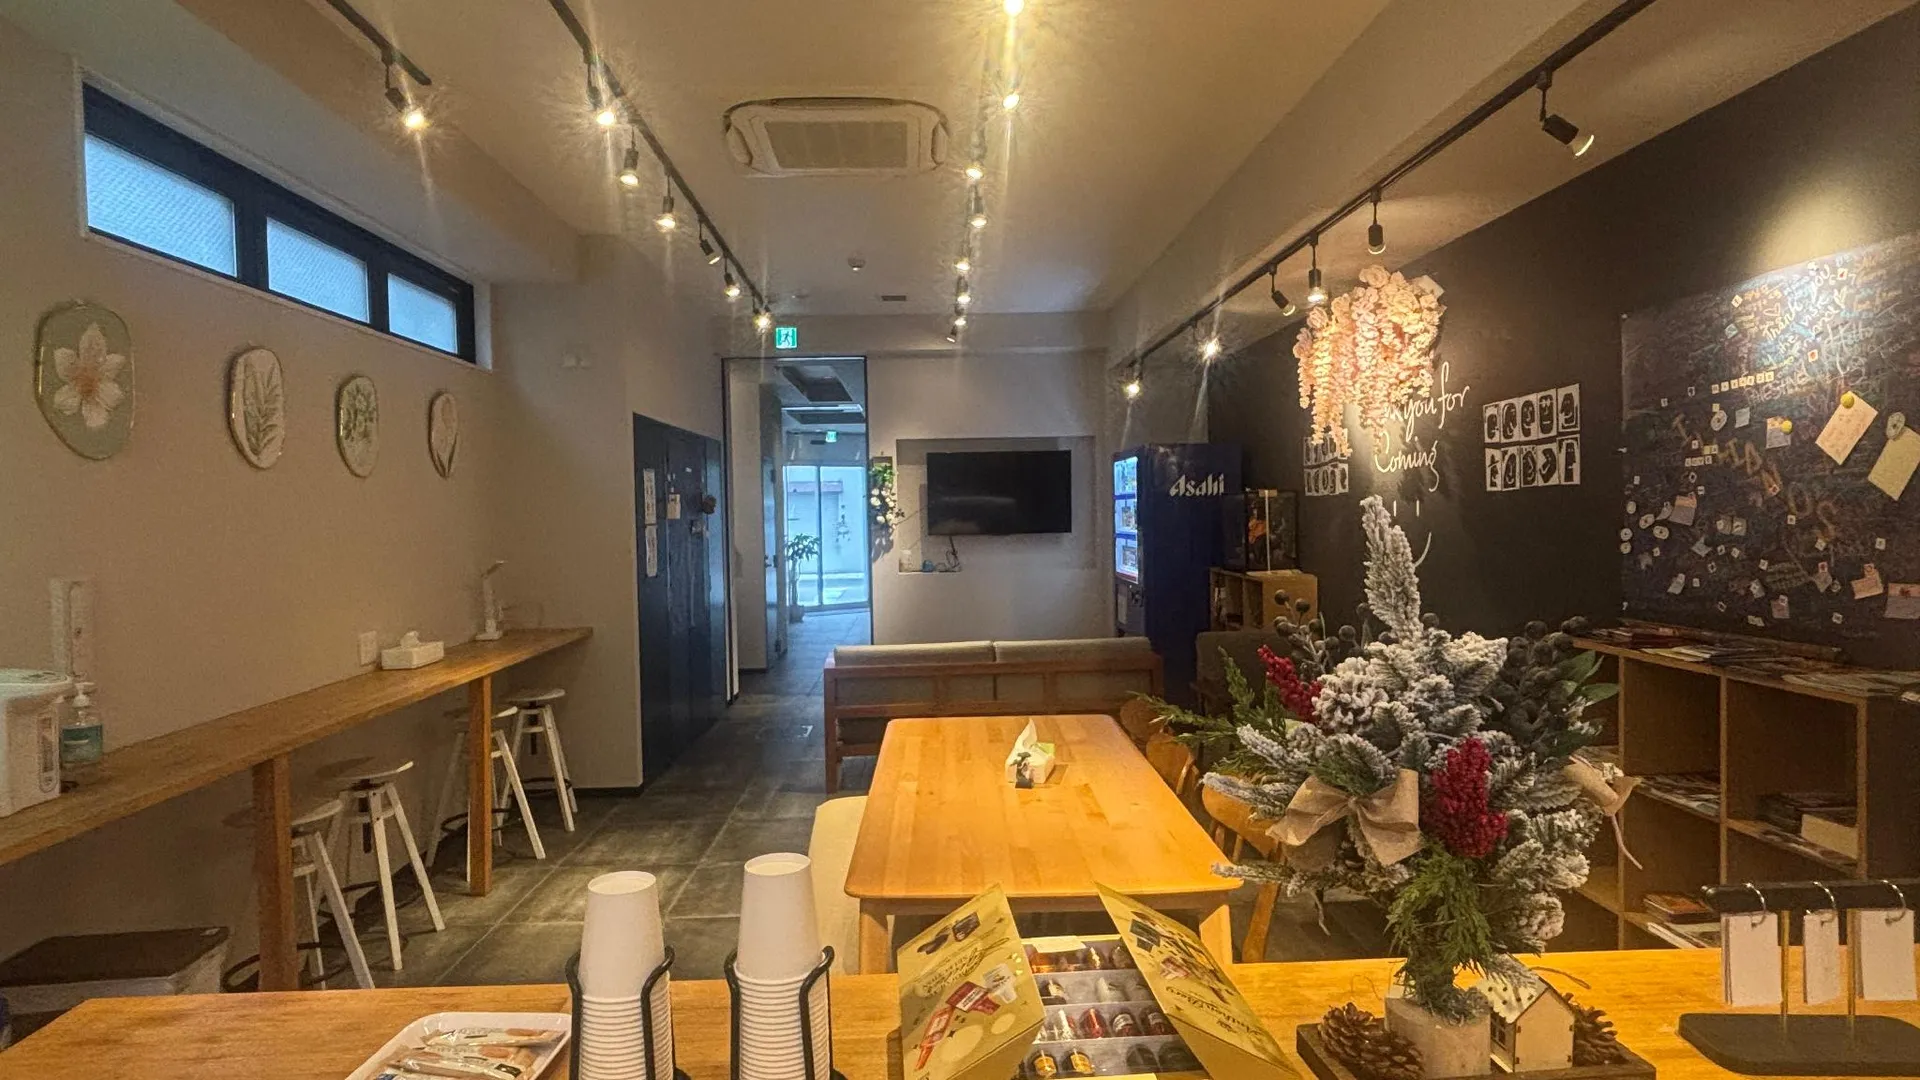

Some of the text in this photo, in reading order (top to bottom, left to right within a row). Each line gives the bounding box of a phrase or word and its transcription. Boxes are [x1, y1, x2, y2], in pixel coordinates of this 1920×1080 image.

[1403, 361, 1470, 442] you for
[1169, 473, 1225, 497] Asahi
[1374, 430, 1440, 492] Coming
